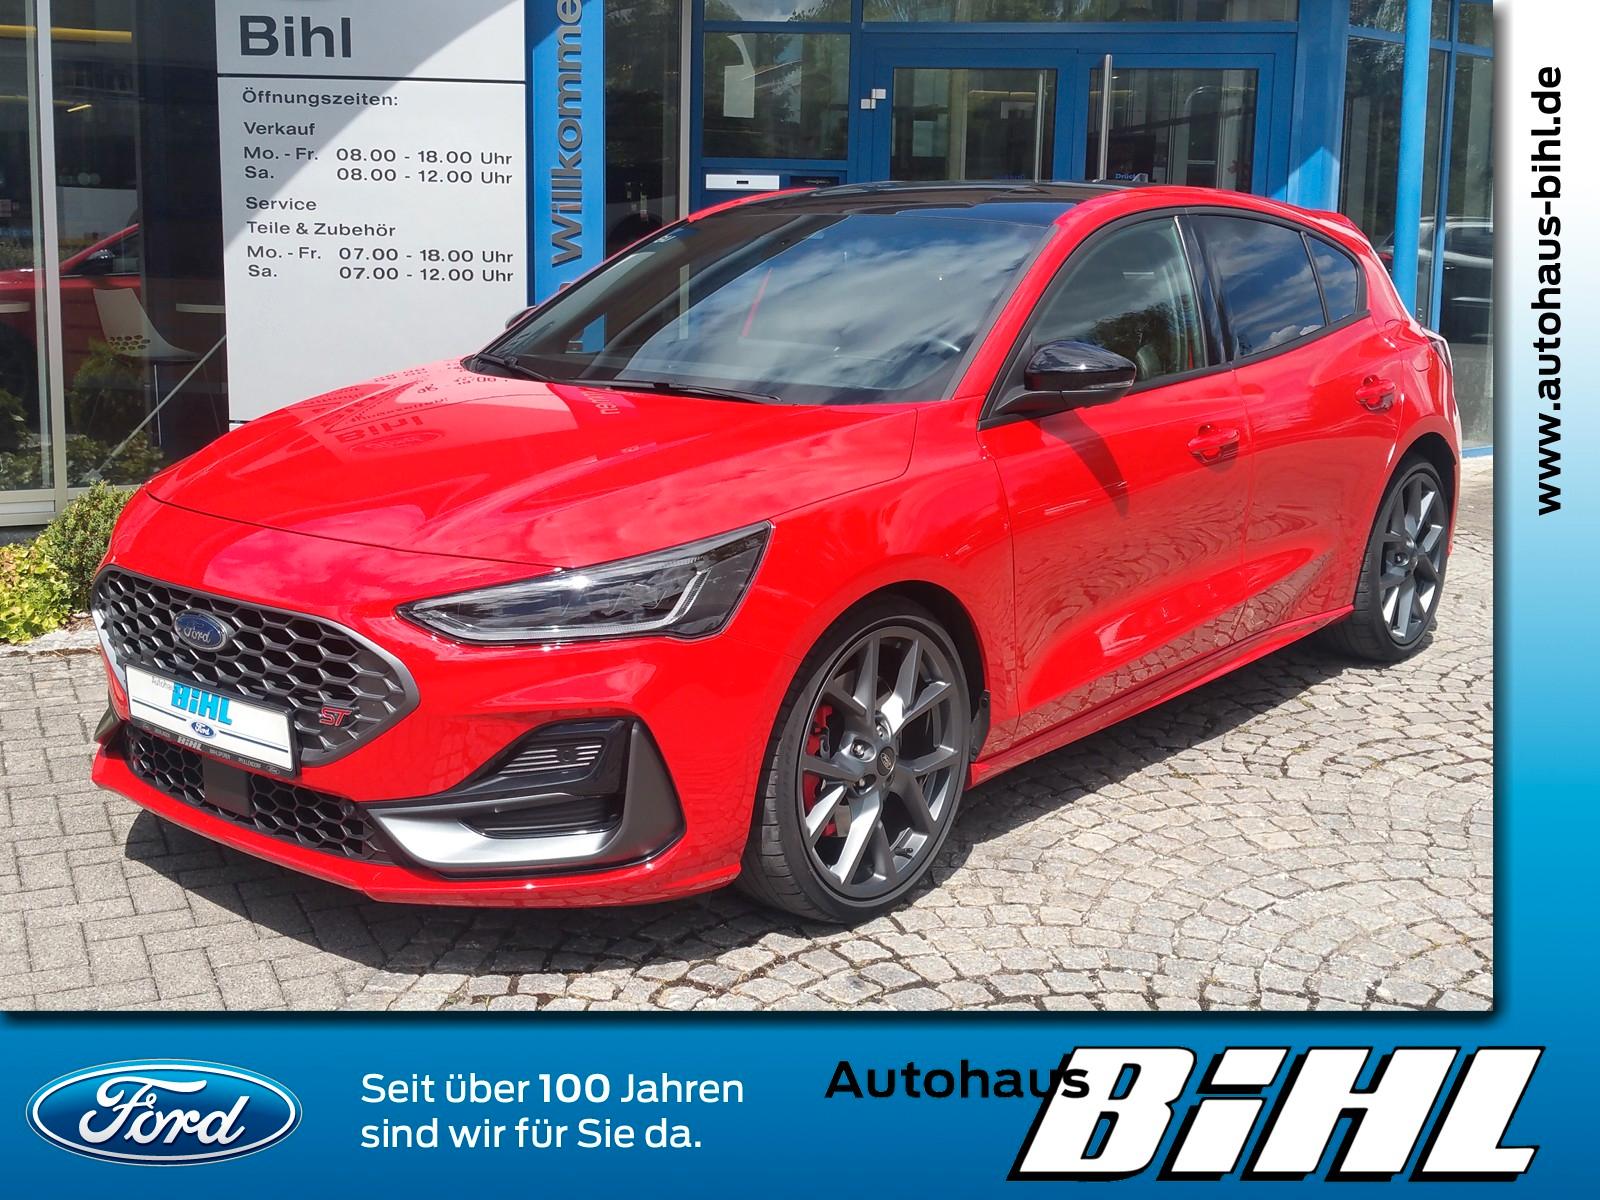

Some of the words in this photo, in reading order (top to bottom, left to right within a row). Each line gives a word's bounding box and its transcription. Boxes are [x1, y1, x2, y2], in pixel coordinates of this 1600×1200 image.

[239, 15, 352, 58] Bihl
[242, 87, 398, 107] Öffnungszeiten:
[243, 121, 316, 136] Verkauf
[243, 146, 279, 160] Mo.
[295, 147, 318, 161] Fr.
[336, 148, 396, 162] 08.00
[417, 150, 472, 164] 18.00
[480, 152, 512, 165] Uhr
[244, 166, 275, 179] Sa.
[337, 168, 397, 182] 08.00
[418, 170, 473, 184] 12.00
[481, 172, 513, 184] Uhr
[245, 196, 317, 211] Service
[246, 221, 290, 235] Teile
[296, 222, 308, 235] &
[314, 222, 396, 237] Zubehör
[247, 245, 282, 259] Mo.
[299, 246, 321, 260] Fr.
[339, 247, 399, 261] 07.00
[419, 249, 474, 263] 18.00
[482, 250, 514, 263] Uhr
[248, 264, 278, 278] Sa.
[339, 266, 399, 280] 07.00
[420, 268, 474, 282] 12.00
[482, 269, 514, 282] Uhr
[319, 707, 352, 727] ST
